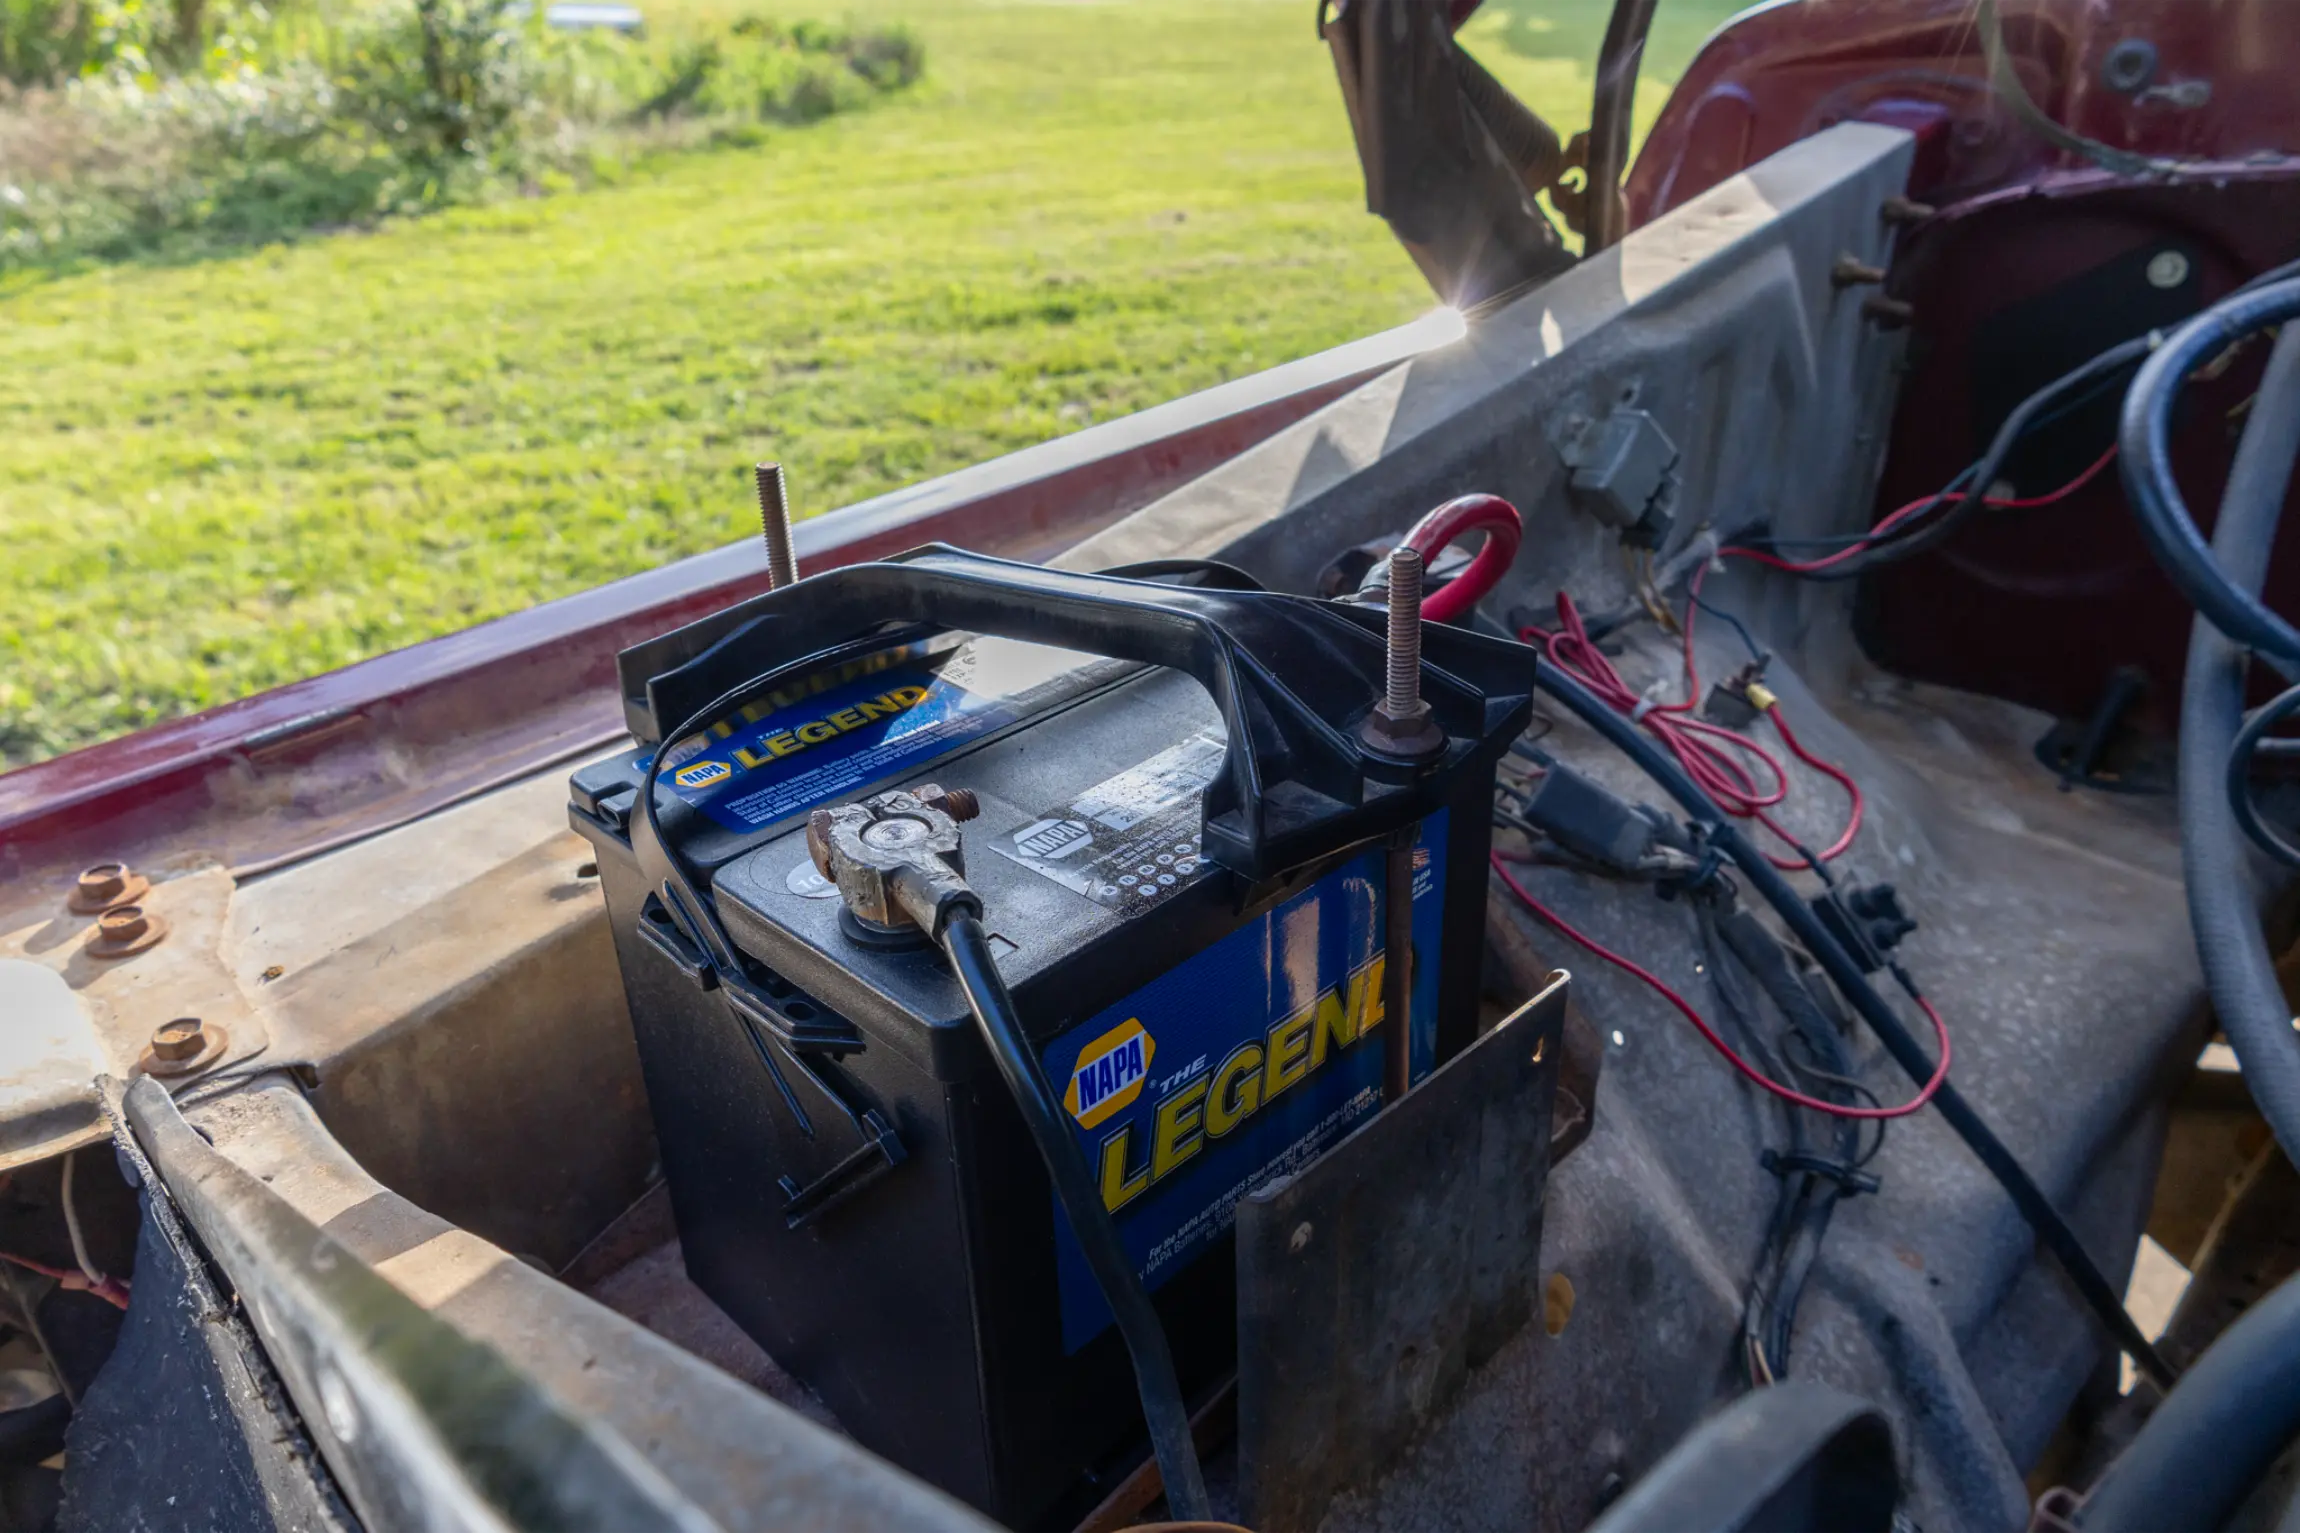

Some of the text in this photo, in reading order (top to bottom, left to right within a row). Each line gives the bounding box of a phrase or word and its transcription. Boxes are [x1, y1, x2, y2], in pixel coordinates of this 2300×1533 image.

[728, 685, 928, 771] LEGEND
[682, 764, 727, 785] NAPA
[1027, 821, 1083, 855] NAPA
[1078, 1035, 1144, 1112] NAPA
[1160, 1054, 1206, 1093] THE
